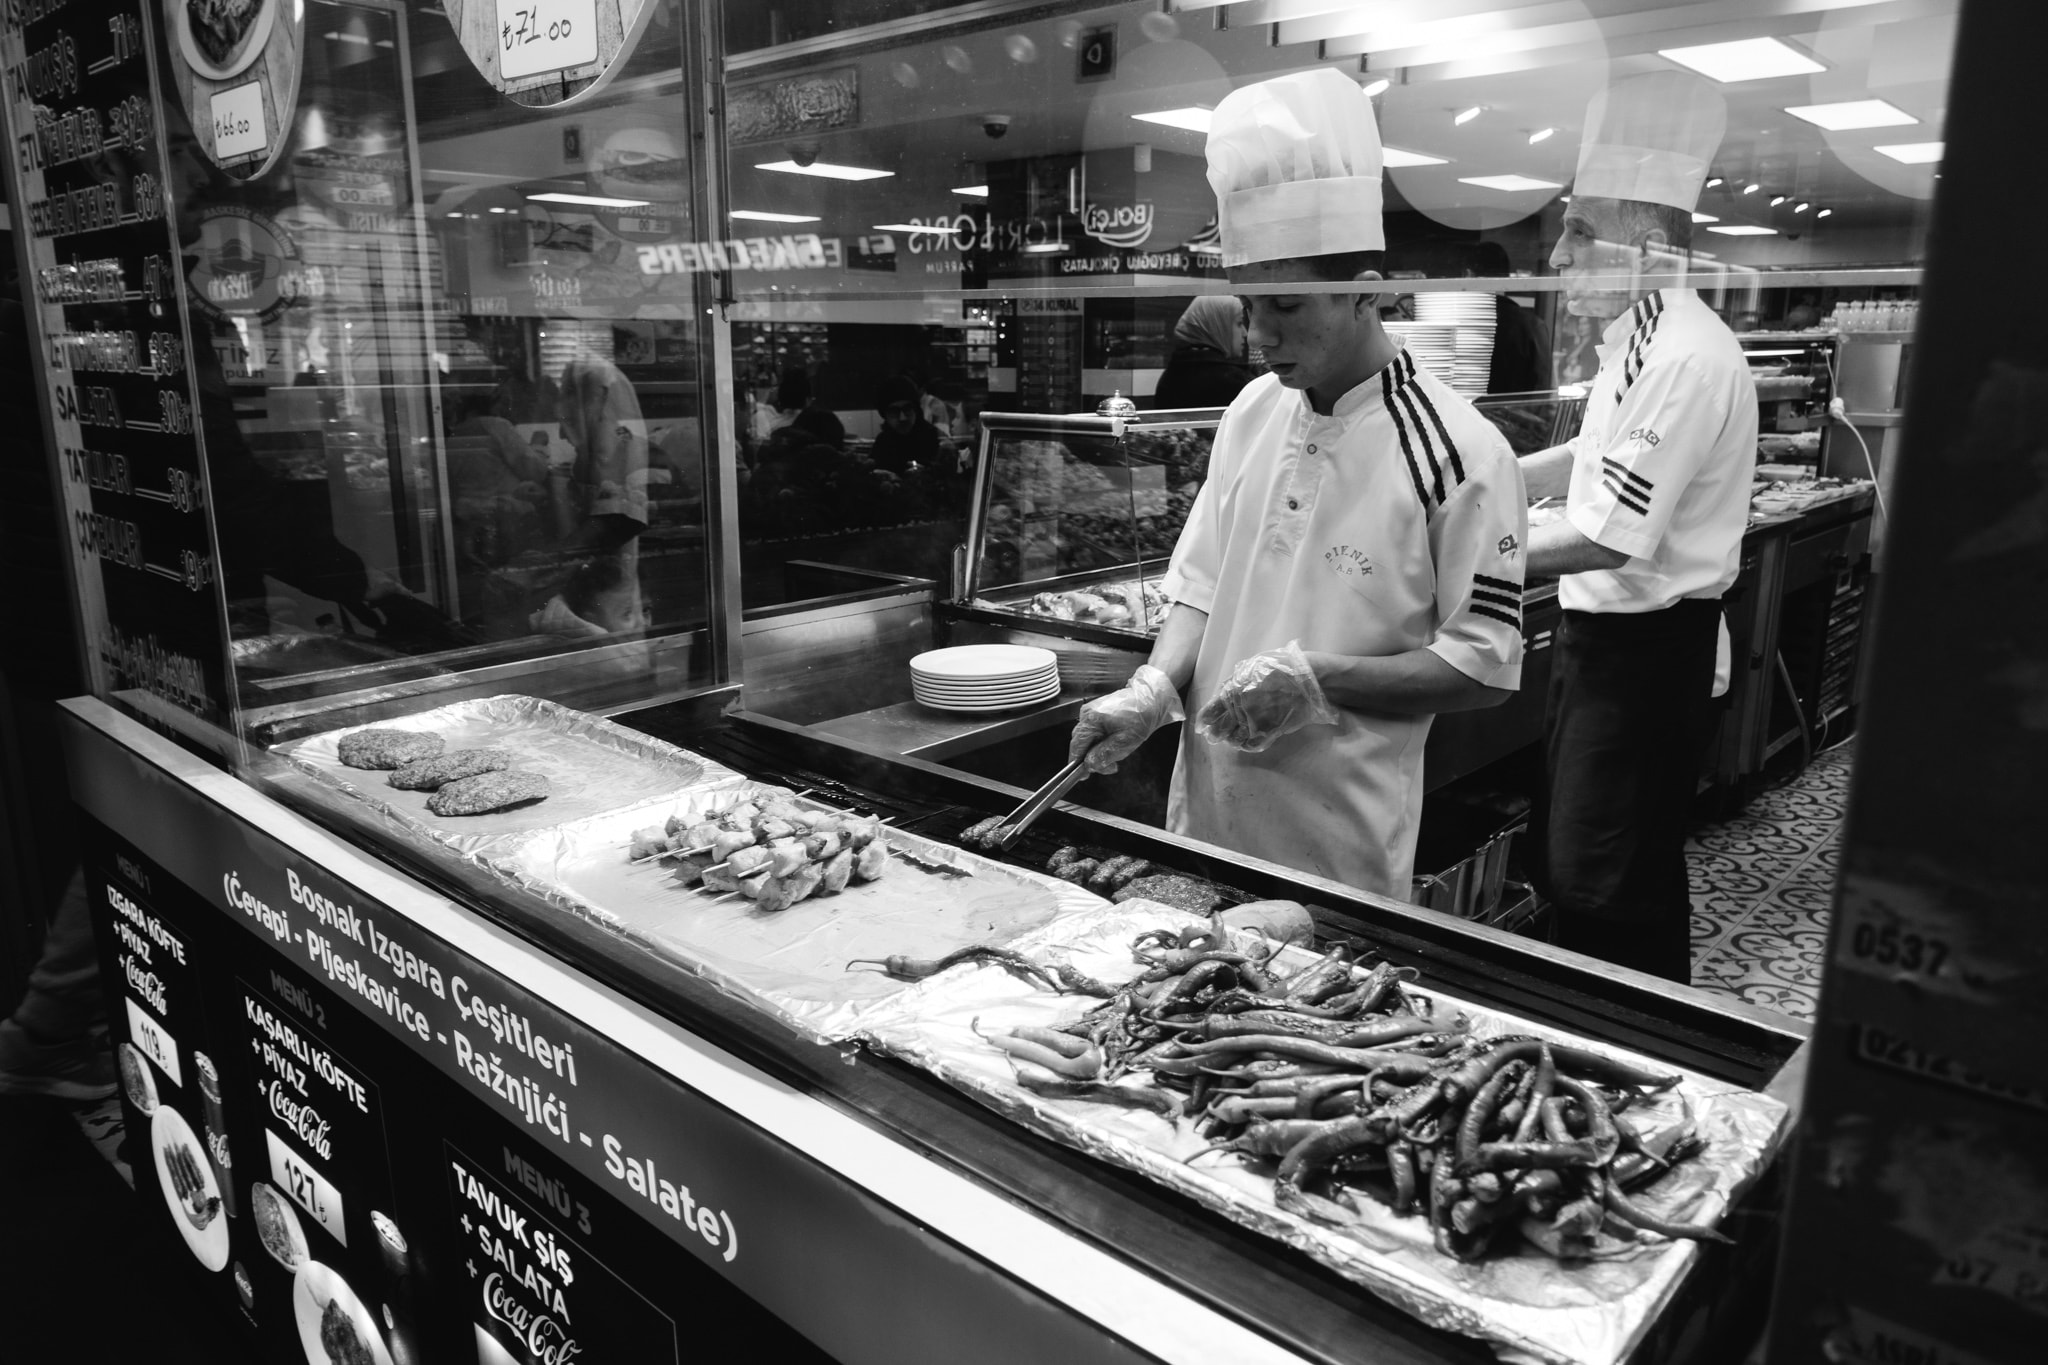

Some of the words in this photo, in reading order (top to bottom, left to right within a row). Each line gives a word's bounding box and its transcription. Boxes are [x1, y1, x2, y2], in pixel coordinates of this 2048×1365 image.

[503, 5, 572, 50] ₺71.00
[215, 111, 250, 139] ₺66.00
[1046, 298, 1079, 313] KURAL
[56, 385, 124, 430] SALATA
[65, 449, 135, 497] TATLILAR
[75, 509, 143, 571] ÇORBALAR
[107, 885, 146, 933] IZGARA
[147, 916, 187, 966] KÖFTE
[121, 922, 152, 965] PİYAZ
[1854, 922, 1950, 977] 0537
[270, 969, 315, 1017] MENÜ
[316, 1007, 328, 1030] 2
[286, 868, 365, 947] Boşnak
[368, 919, 446, 999] Izgara
[451, 975, 577, 1086] Çeşitleri
[223, 871, 292, 945] (Ćevapi
[307, 934, 430, 1043] Pljeskavice
[454, 1035, 571, 1144] Ražnjići
[579, 1132, 592, 1147] -
[602, 1133, 738, 1263] Salate)
[245, 996, 309, 1066] KAŞARLI
[312, 1047, 369, 1113] KÖFTE
[251, 1038, 261, 1054] +
[262, 1042, 309, 1097] PİYAZ
[258, 1079, 268, 1097] +
[268, 1079, 333, 1161] Coca-Cola
[503, 1146, 571, 1218] MENÜ
[575, 1202, 592, 1236] 3
[452, 1161, 530, 1249] TAVUK
[533, 1230, 574, 1287] ŞİŞ
[461, 1213, 473, 1234] +
[478, 1225, 571, 1326] SALATA
[466, 1258, 477, 1278] +
